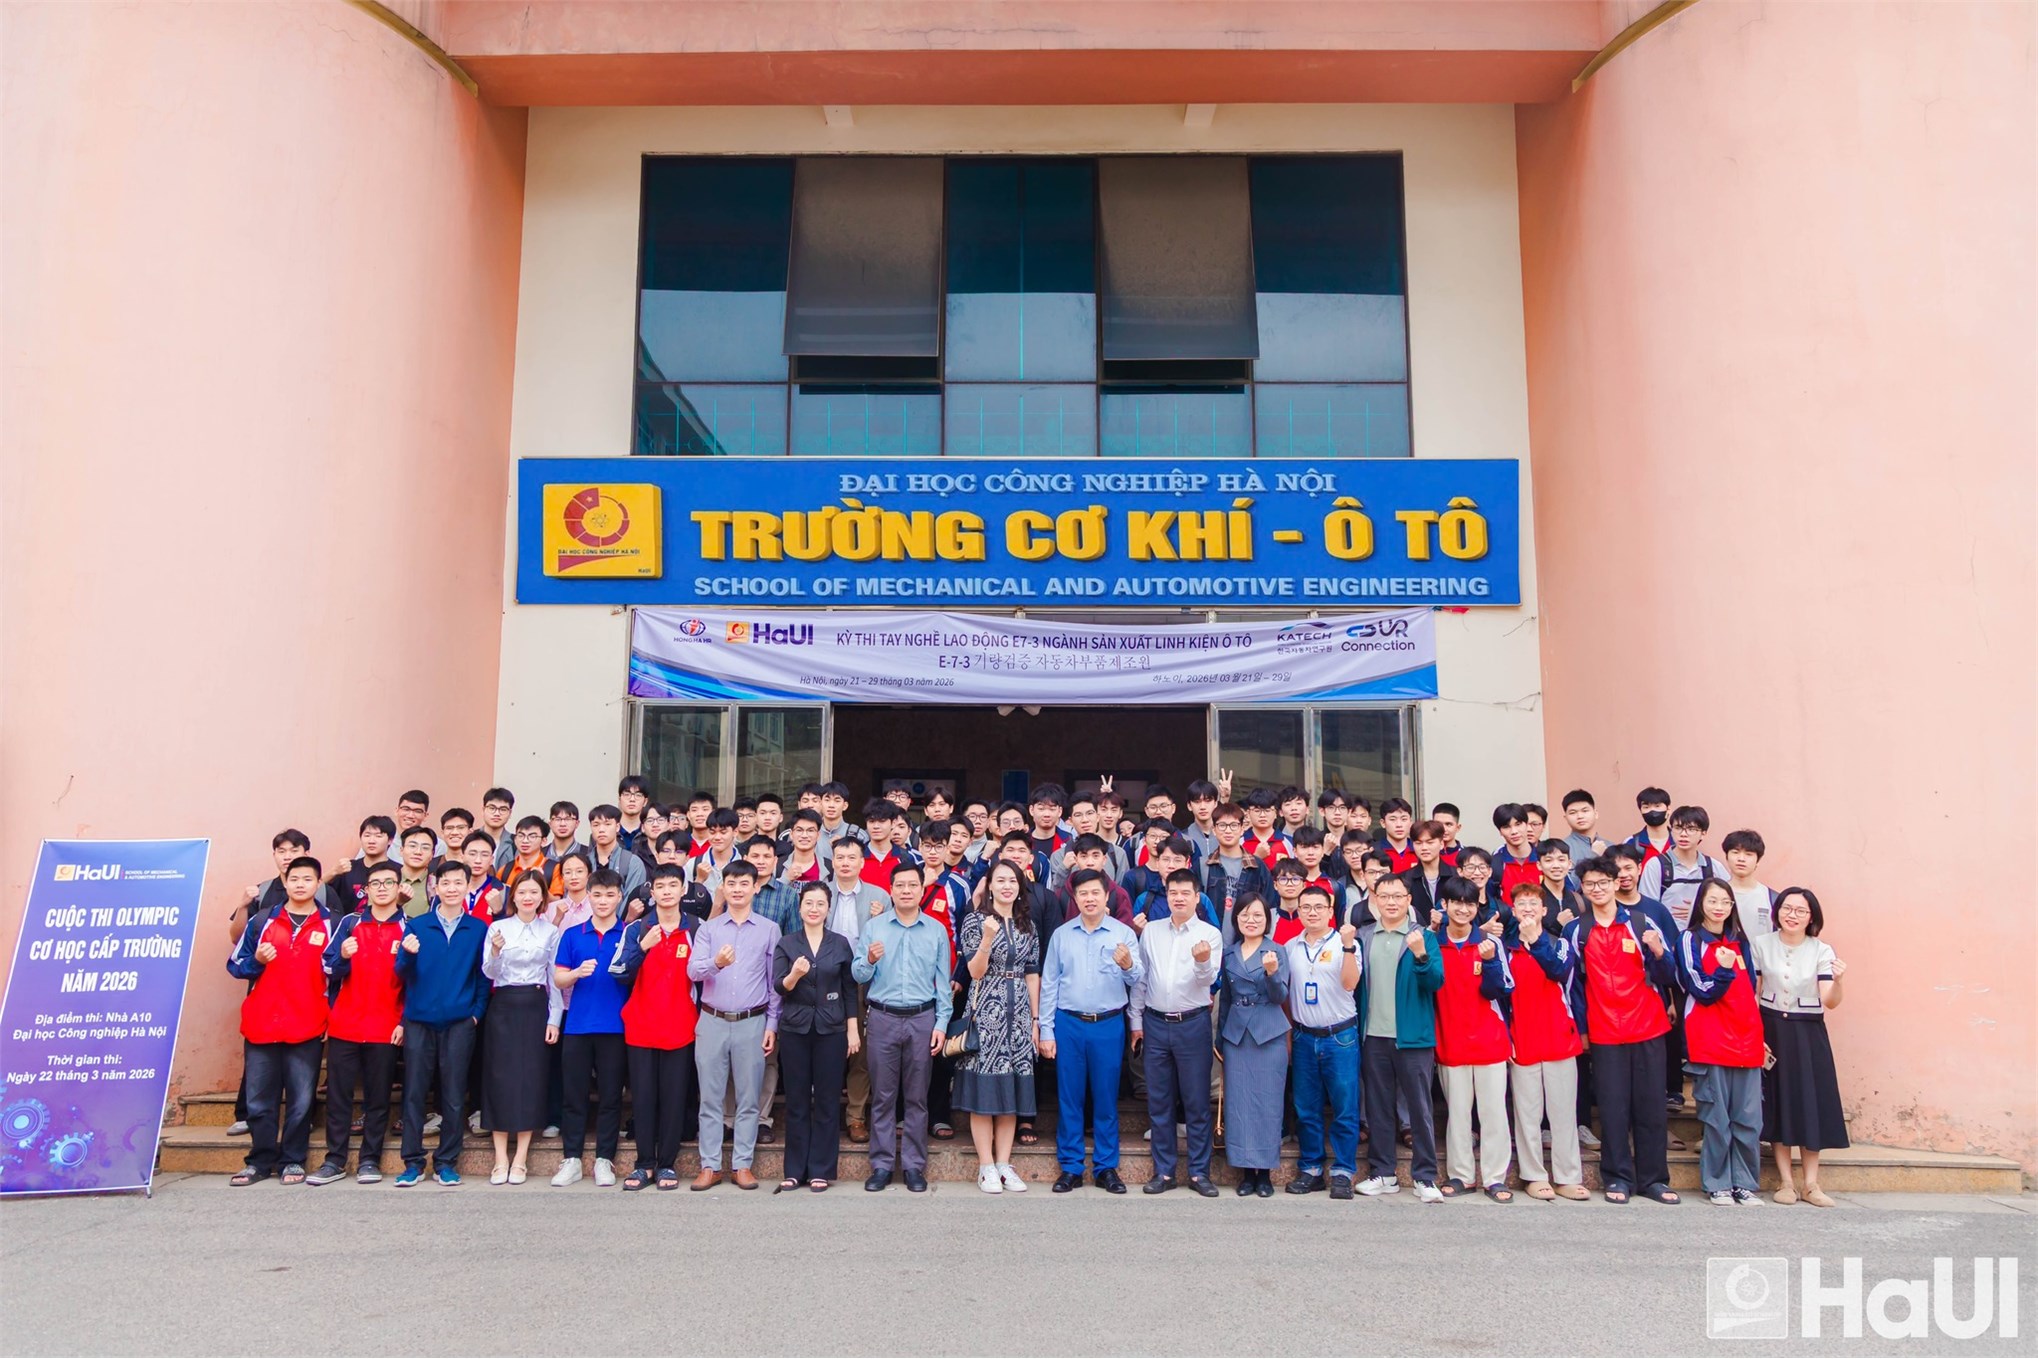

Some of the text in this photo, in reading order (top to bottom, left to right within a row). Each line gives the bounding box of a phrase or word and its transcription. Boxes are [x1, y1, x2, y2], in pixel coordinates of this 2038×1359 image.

[839, 468, 1337, 498] ĐẠI HỌC CÔNG NGHIỆP HÀ NỘI
[691, 498, 986, 561] TRƯỜNG
[1005, 504, 1108, 561] CƠ
[1128, 497, 1255, 561] KHÍ
[1324, 496, 1374, 560] Ô
[1395, 496, 1488, 560] TÔ
[694, 577, 1490, 597] SCHOOL OF MECHANICAL AND AUTOMOTIVE ENGINEERING
[753, 623, 813, 645] HaUI
[837, 629, 853, 647] KỲ
[855, 633, 876, 647] THI
[879, 633, 901, 647] TAY
[905, 630, 940, 647] NGHỀ
[943, 634, 968, 647] LAO
[972, 632, 1009, 651] ĐỘNG
[1013, 635, 1039, 649] E7-3
[1043, 633, 1088, 650] NGÀNH
[1119, 633, 1152, 650] XUẤT
[1155, 637, 1185, 650] LINH
[1189, 634, 1219, 653] KIỆN
[1222, 634, 1232, 648] Ô
[1235, 633, 1252, 648] TÔ
[1277, 632, 1332, 642] KATECH
[1341, 639, 1415, 652] Connection
[939, 652, 1152, 671] E-7-3 기량검증 자동차부품제조원
[800, 676, 811, 685] Hà
[812, 676, 827, 686] Nội,
[830, 677, 848, 687] ngày
[850, 676, 860, 685] 21
[868, 677, 878, 686] 29
[880, 676, 902, 687] tháng
[904, 678, 914, 686] 03
[916, 678, 933, 686] năm
[935, 678, 954, 687] 2026
[1187, 673, 1218, 683] 2026년
[1272, 671, 1292, 682] 29일
[75, 864, 121, 880] HaUI
[45, 905, 180, 931] CUỘC THI OLYMPIC
[29, 933, 182, 964] CƠ HỌC CẤP TRƯỜNG
[61, 969, 138, 993] NĂM 2026
[35, 1011, 152, 1027] Địa điểm thi: Nhà A10
[13, 1026, 167, 1042] Đại học Công nghiệp Hà Nội
[47, 1054, 122, 1067] Thời gian thi:
[7, 1068, 155, 1085] Ngày 22 tháng 3 năm 2026
